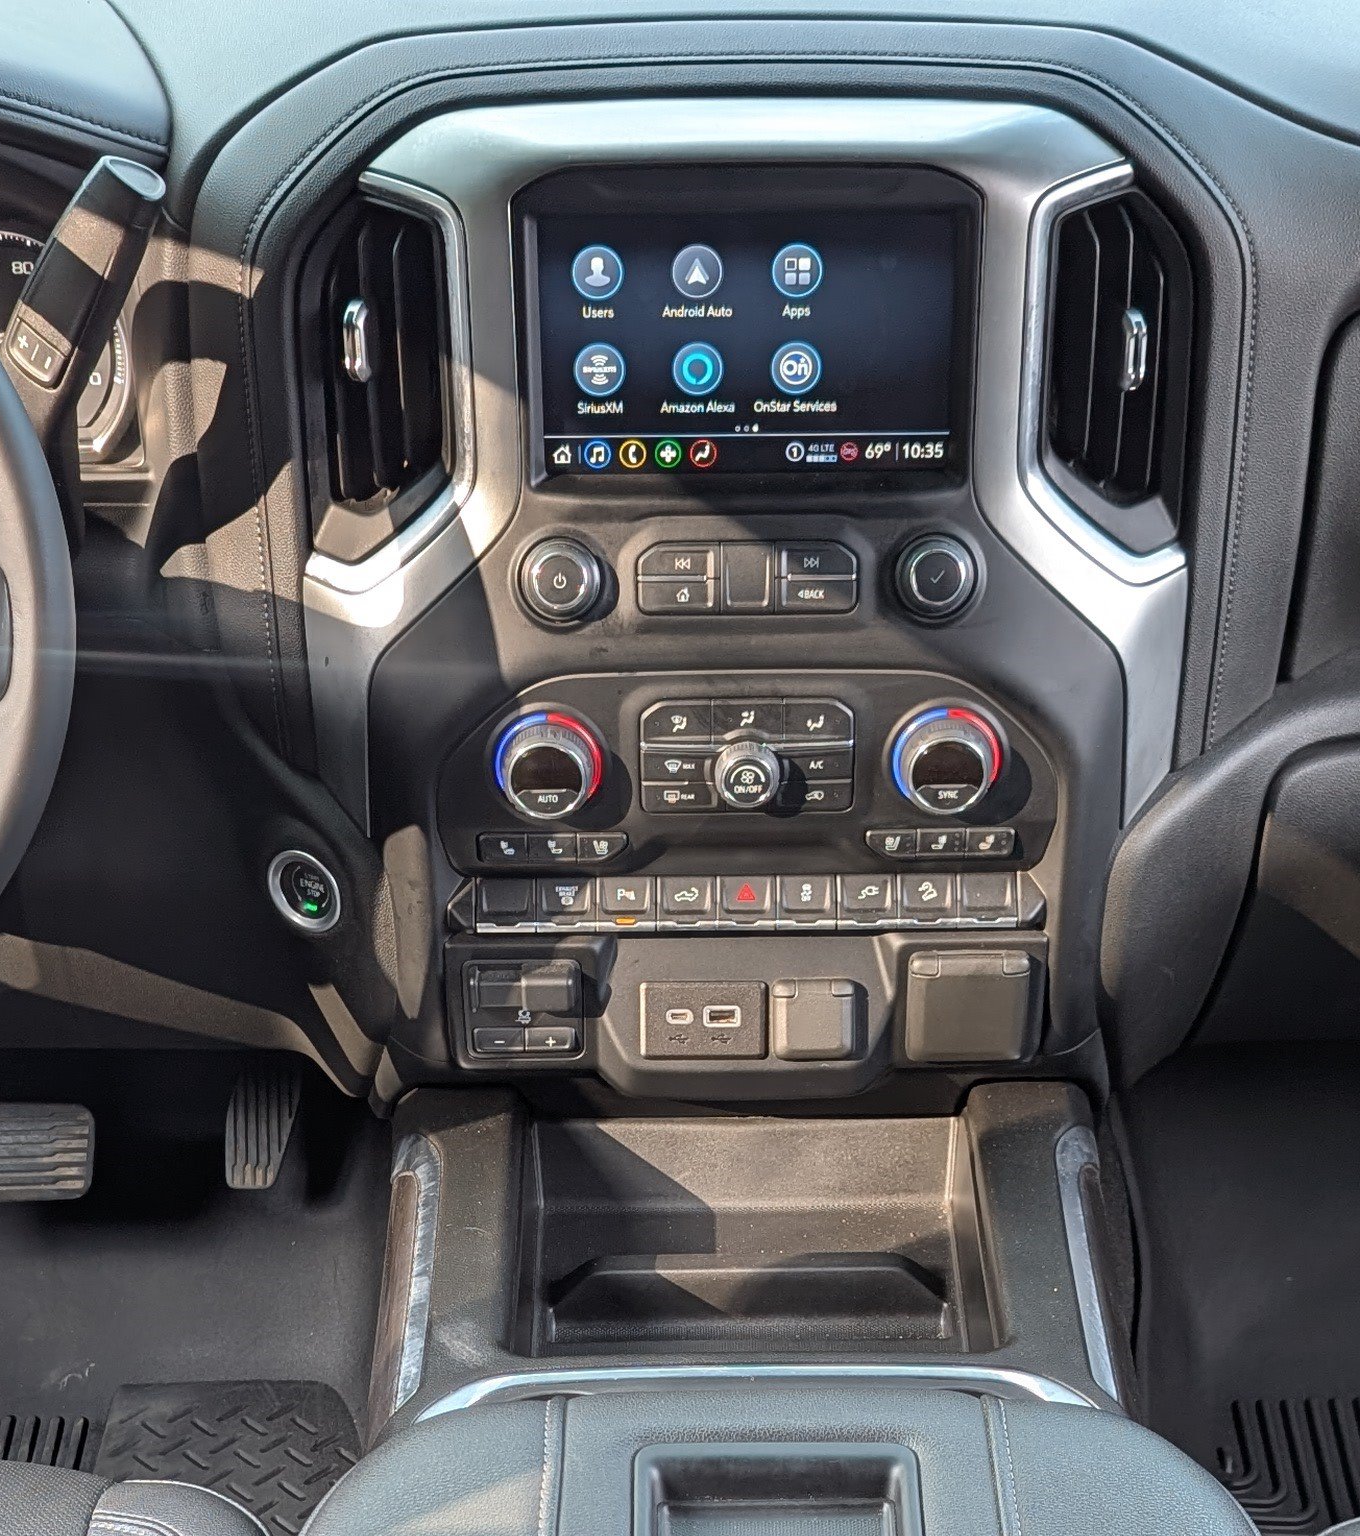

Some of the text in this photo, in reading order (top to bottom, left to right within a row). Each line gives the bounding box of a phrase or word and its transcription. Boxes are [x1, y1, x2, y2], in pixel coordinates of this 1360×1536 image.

[12, 261, 33, 275] 80
[582, 307, 615, 318] Users
[662, 306, 733, 318] Android Auto
[782, 305, 811, 319] Apps
[577, 402, 624, 414] SiriusXM
[660, 401, 735, 413] Amazon Alexa
[754, 400, 837, 413] OnStar Services
[821, 444, 835, 452] LTE
[903, 442, 944, 459] 10:35
[804, 589, 825, 599] BACK
[809, 760, 824, 769] A/C
[733, 785, 763, 794] ON/OFF
[938, 790, 959, 799] SYNC
[538, 795, 558, 803] AUTO
